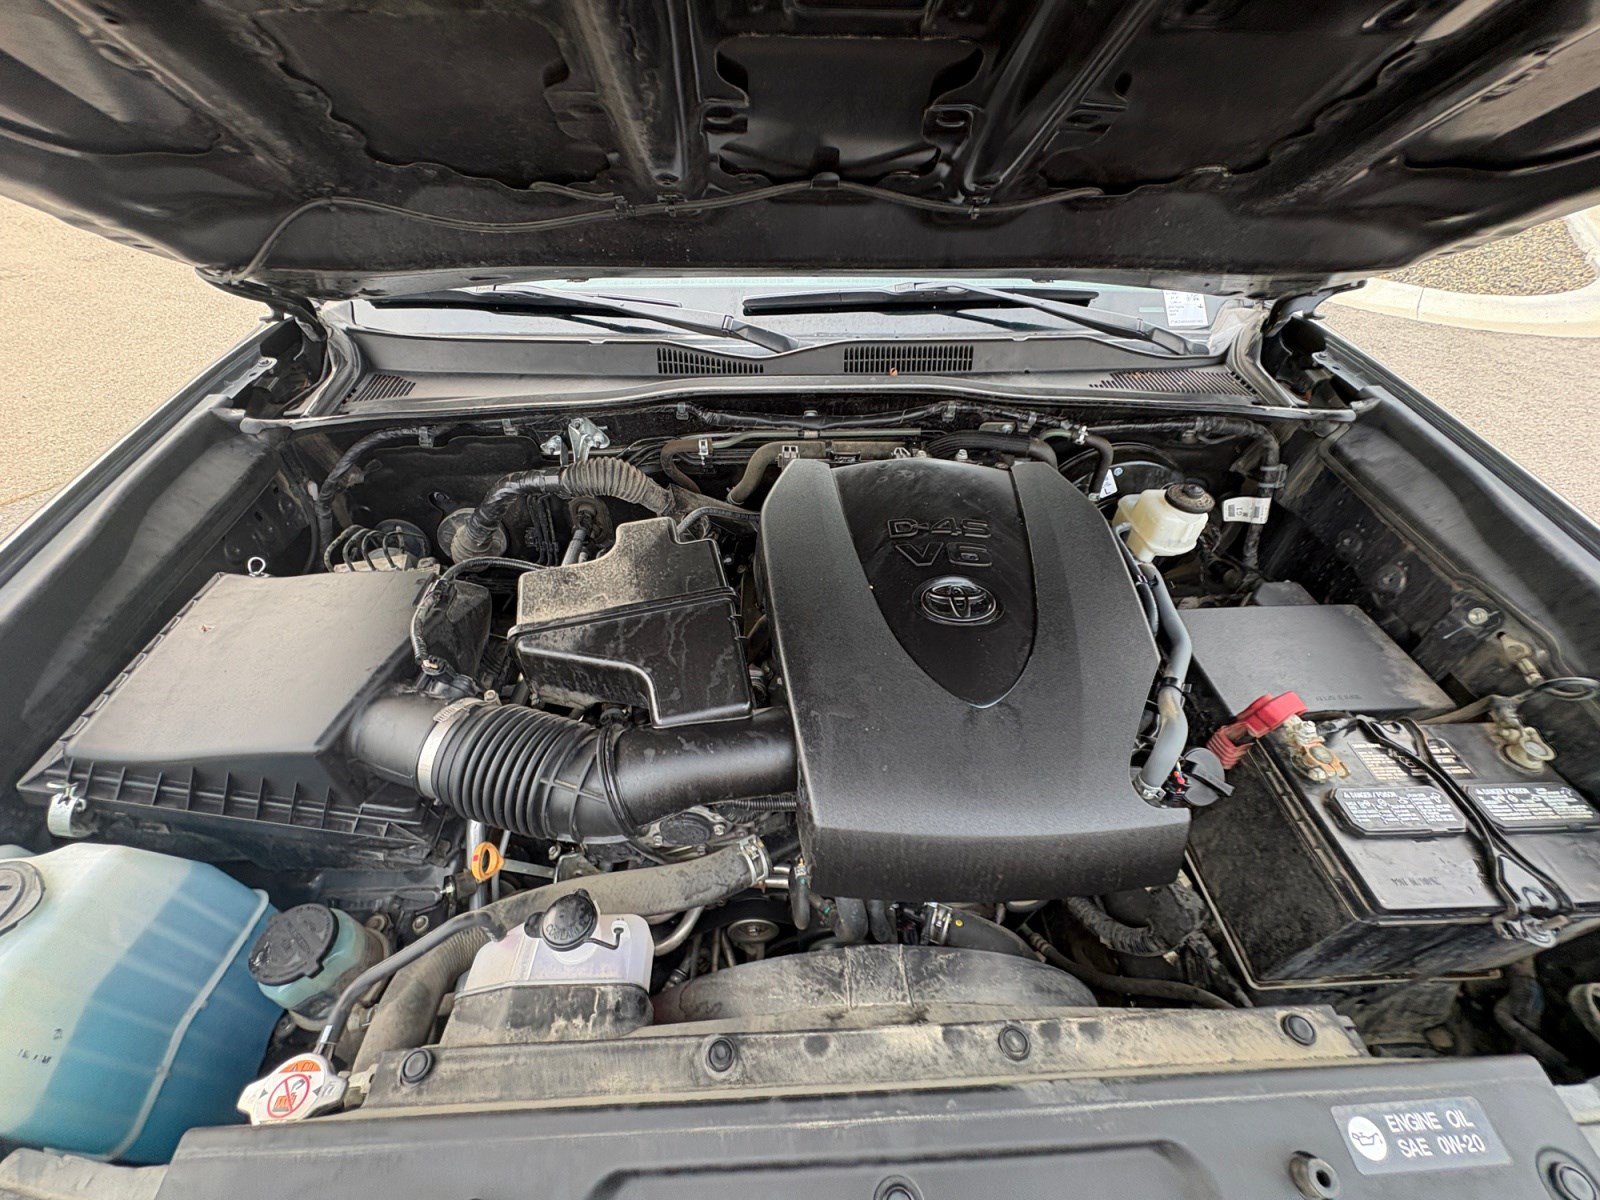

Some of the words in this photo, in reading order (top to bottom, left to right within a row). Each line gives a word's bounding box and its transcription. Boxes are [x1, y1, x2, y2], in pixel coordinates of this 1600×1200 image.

[887, 517, 991, 538] D-4S
[895, 541, 992, 567] V6
[1384, 1111, 1442, 1133] ENGINE
[1446, 1109, 1475, 1129] OIL
[1397, 1137, 1434, 1158] SAE
[1437, 1134, 1486, 1155] 0W-20
